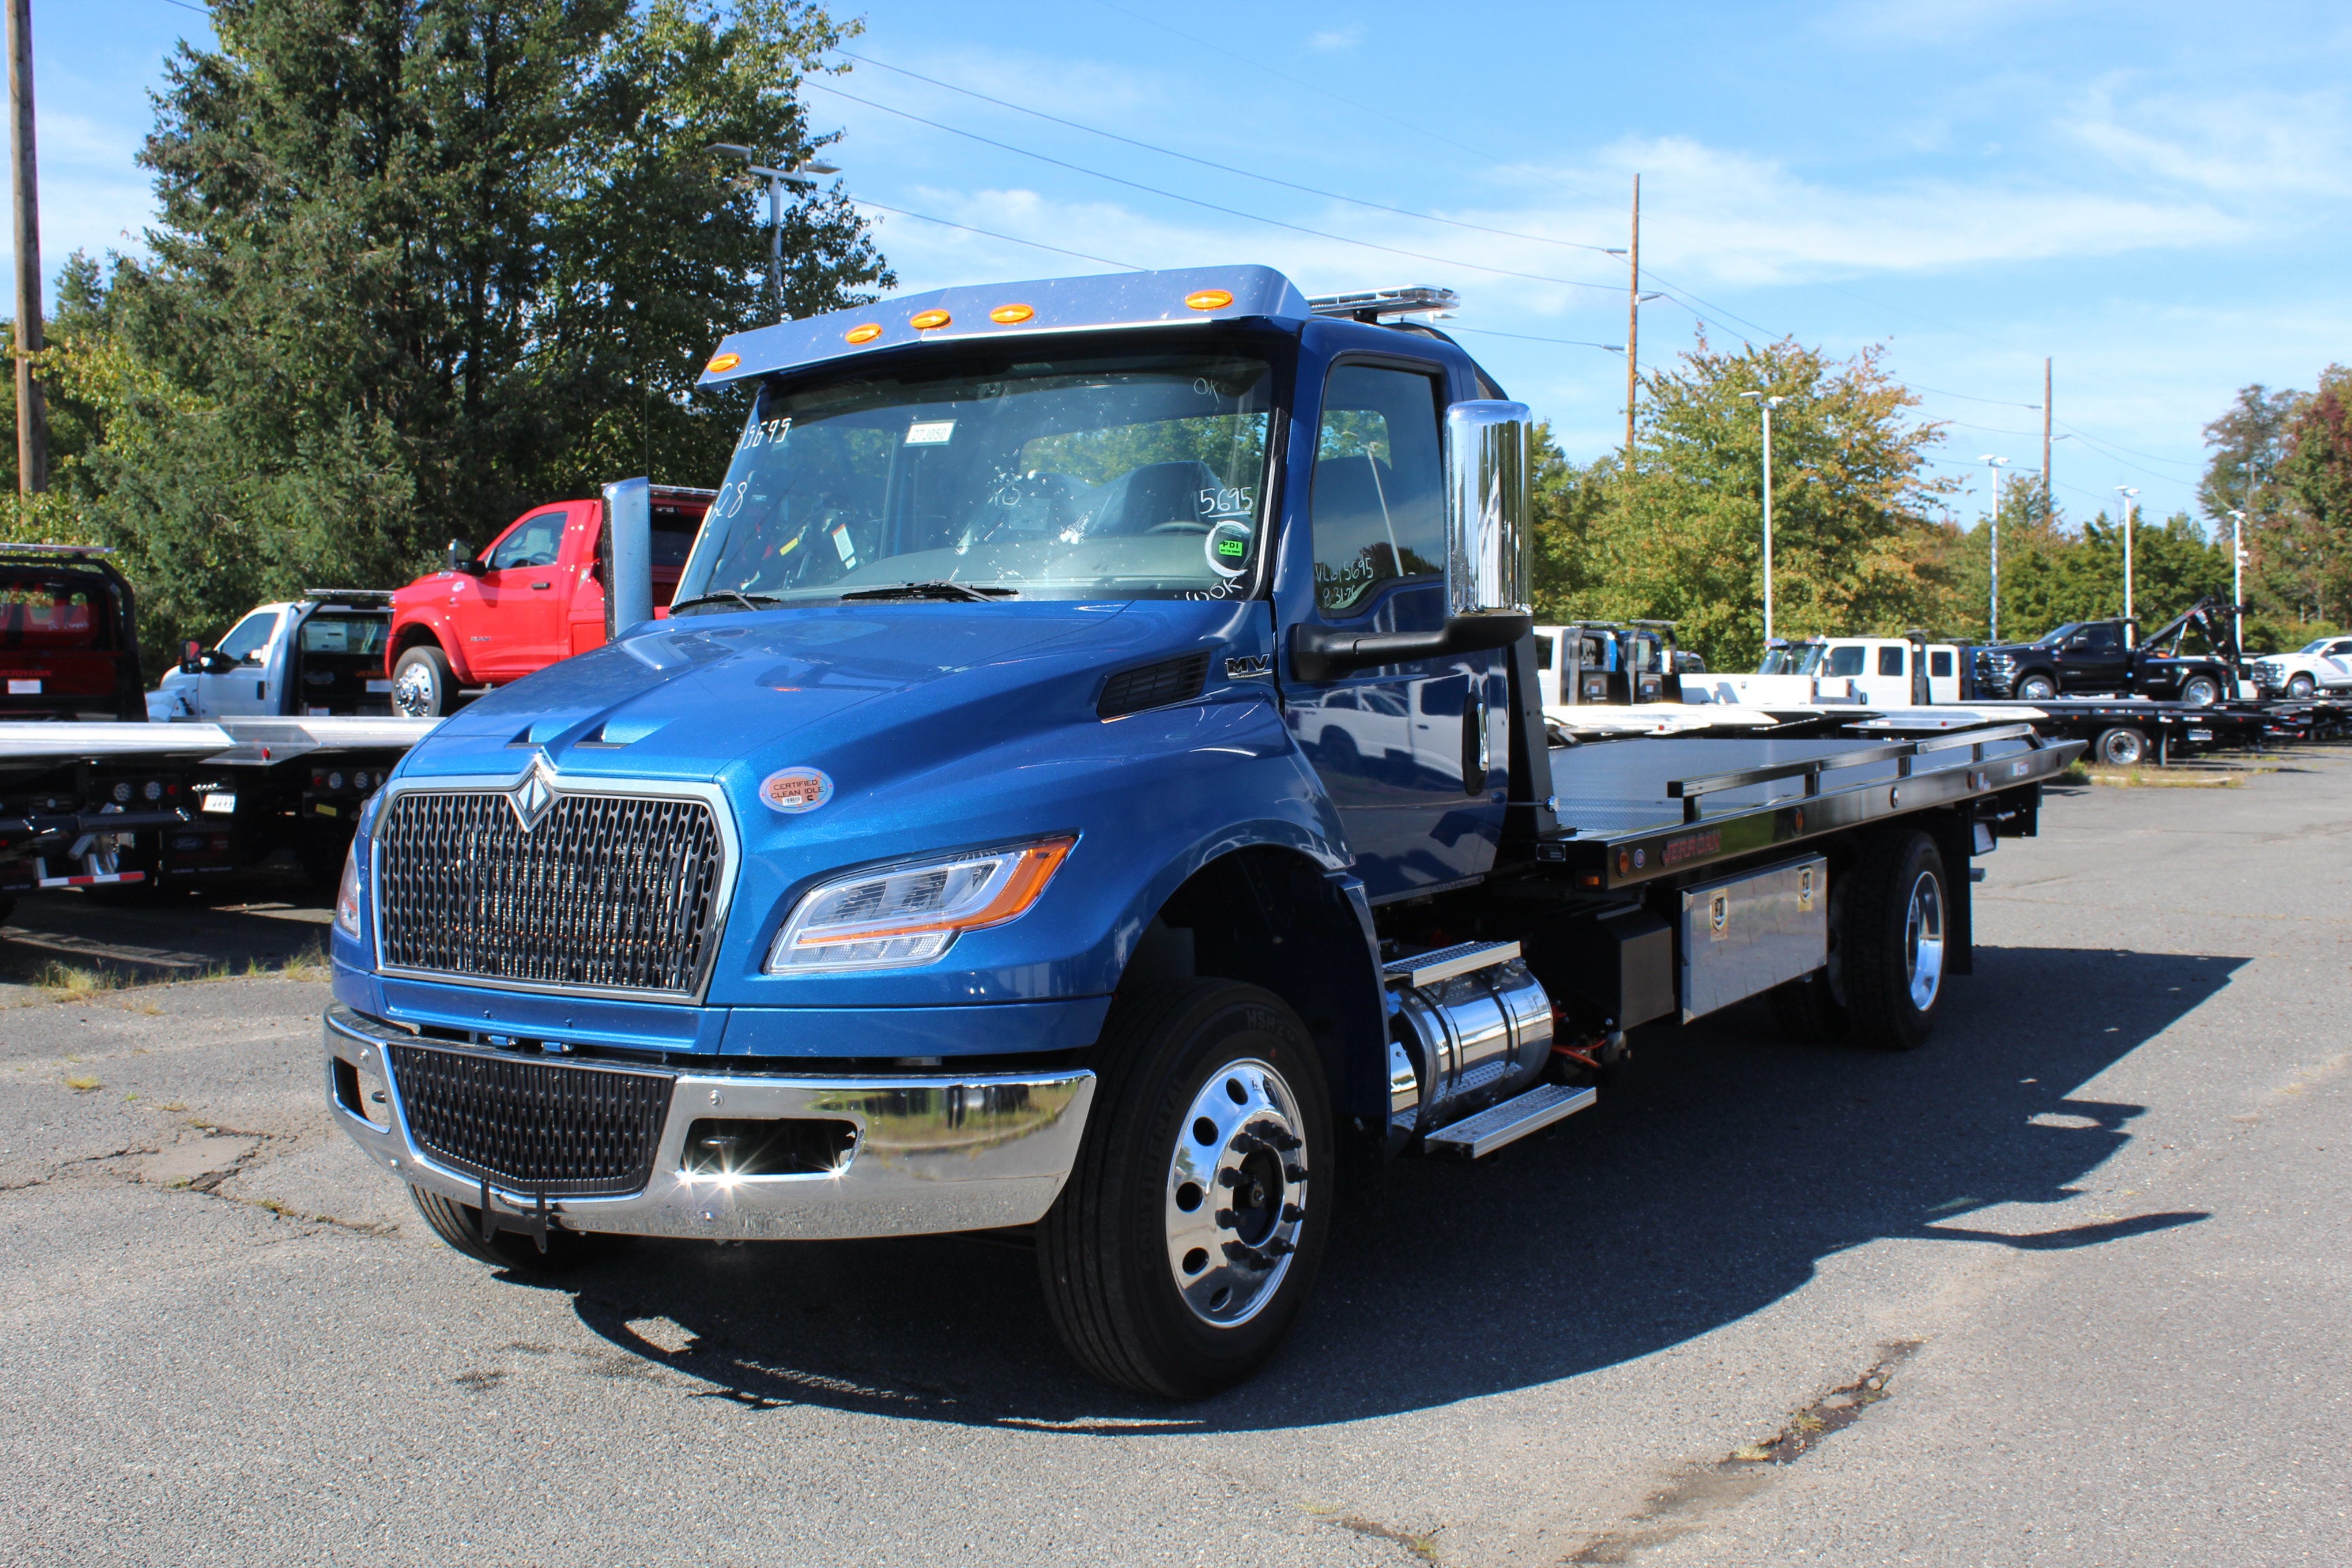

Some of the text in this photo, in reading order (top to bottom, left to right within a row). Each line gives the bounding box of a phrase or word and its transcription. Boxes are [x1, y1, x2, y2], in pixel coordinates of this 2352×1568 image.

[1194, 378, 1220, 404] OK
[912, 427, 947, 442] 27J050
[1200, 487, 1253, 514] 5695
[1222, 541, 1239, 549] PDI
[1225, 653, 1270, 673] MV
[770, 786, 825, 799] CLEAN IDLE
[773, 779, 818, 791] CERTIFIED
